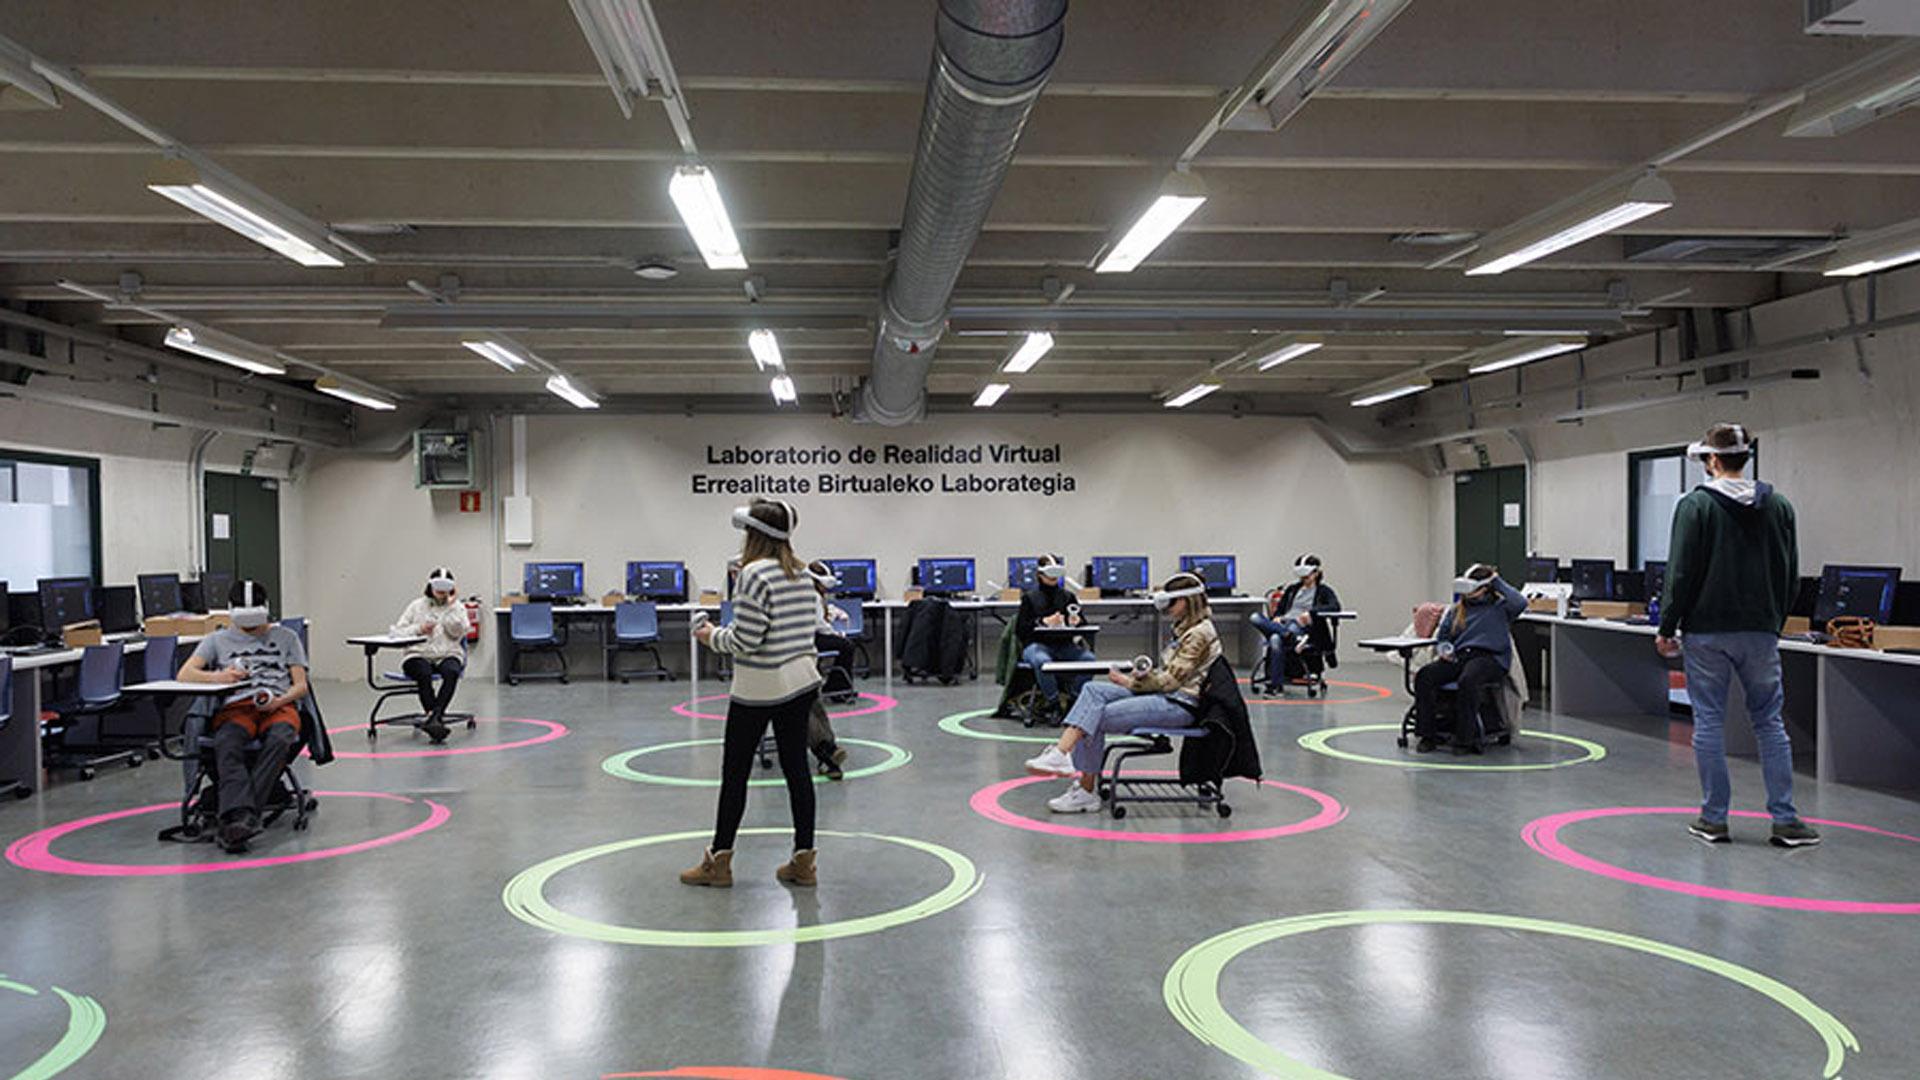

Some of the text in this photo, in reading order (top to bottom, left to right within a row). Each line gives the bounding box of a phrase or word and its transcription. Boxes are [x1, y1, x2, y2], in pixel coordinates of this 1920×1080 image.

[706, 443, 1062, 465] Laboratorio de Realidad Virtual
[691, 473, 1076, 496] Errealitate Birtualeko Laborategia
